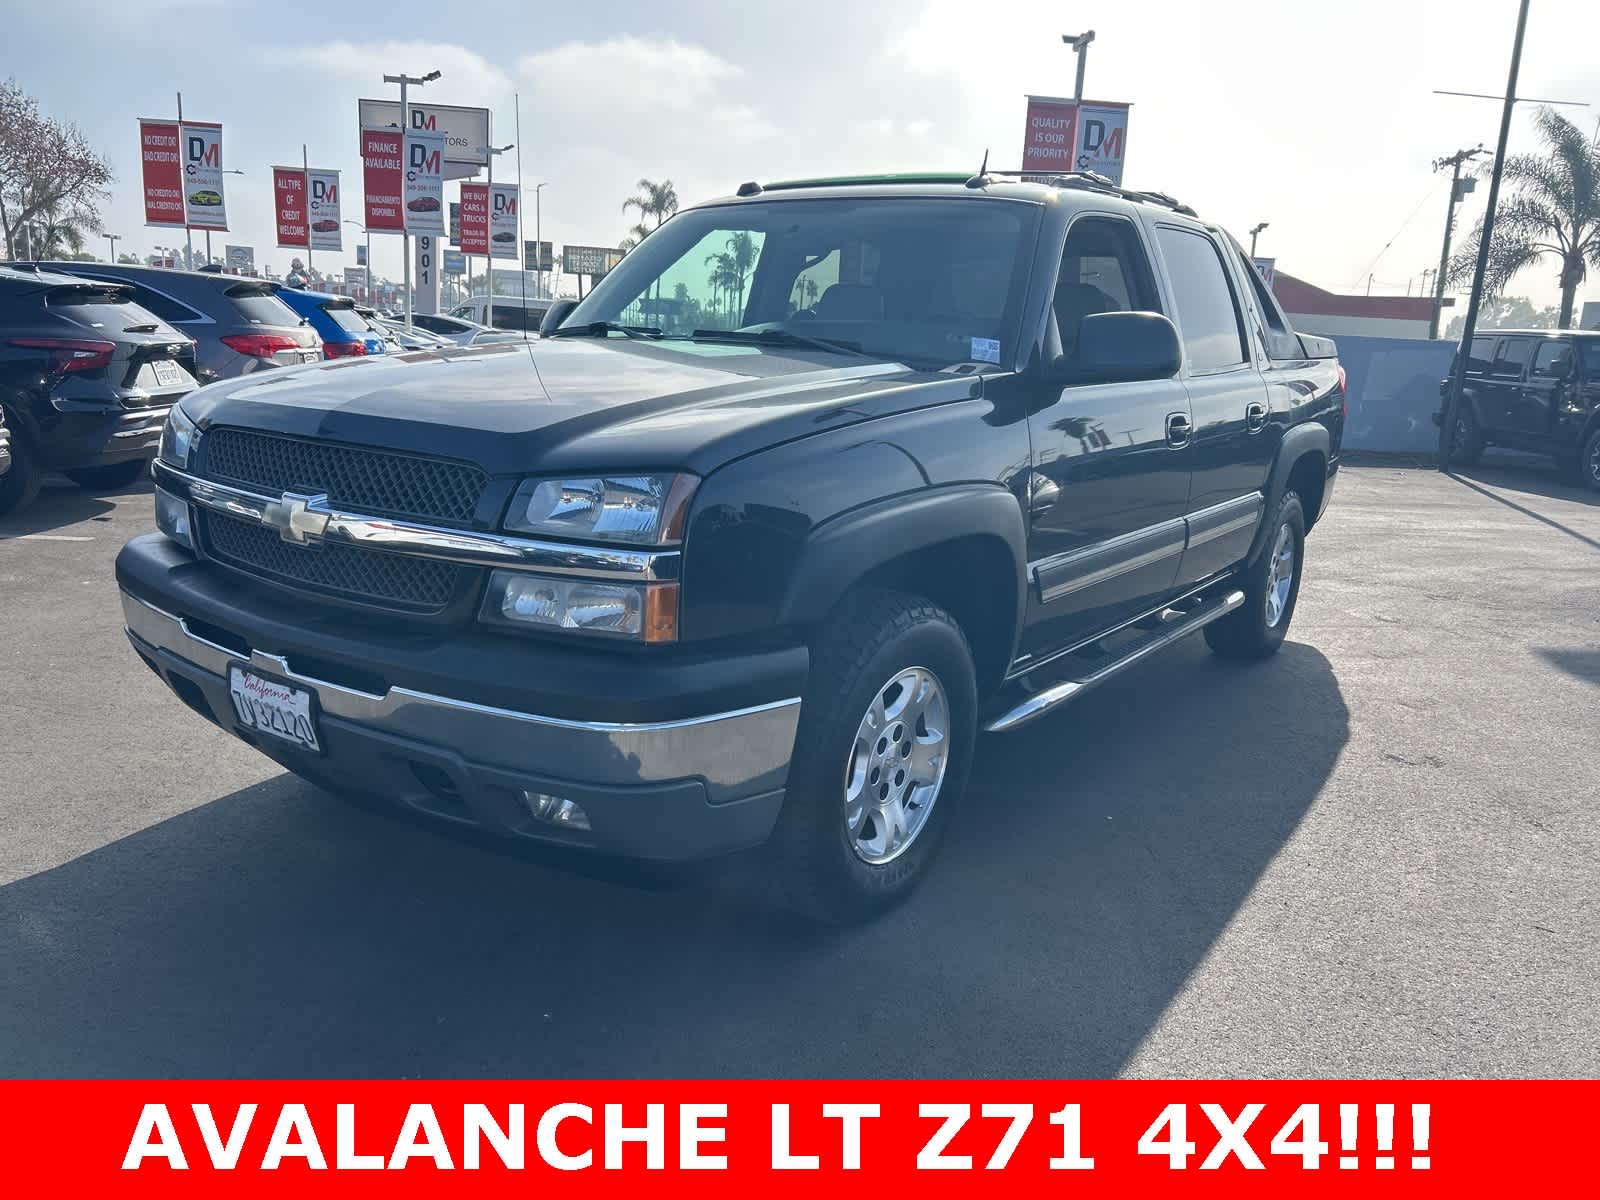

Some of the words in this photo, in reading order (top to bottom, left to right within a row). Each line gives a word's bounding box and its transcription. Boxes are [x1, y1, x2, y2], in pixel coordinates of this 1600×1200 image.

[1032, 118, 1070, 129] QUALITY
[1035, 132, 1043, 141] IS
[1044, 133, 1064, 144] OUR
[368, 142, 398, 153] FINANCE
[1027, 146, 1069, 159] PRIORITY
[365, 158, 400, 169] AVAILABLE
[279, 178, 288, 189] ALL
[288, 179, 301, 190] TYPE
[286, 194, 295, 205] OF
[463, 192, 472, 200] WE
[473, 192, 487, 201] BUY
[463, 203, 479, 211] CARS
[281, 209, 300, 220] CREDIT
[463, 214, 487, 223] TRUCKS
[280, 224, 305, 236] WELCOME
[244, 673, 296, 705] California
